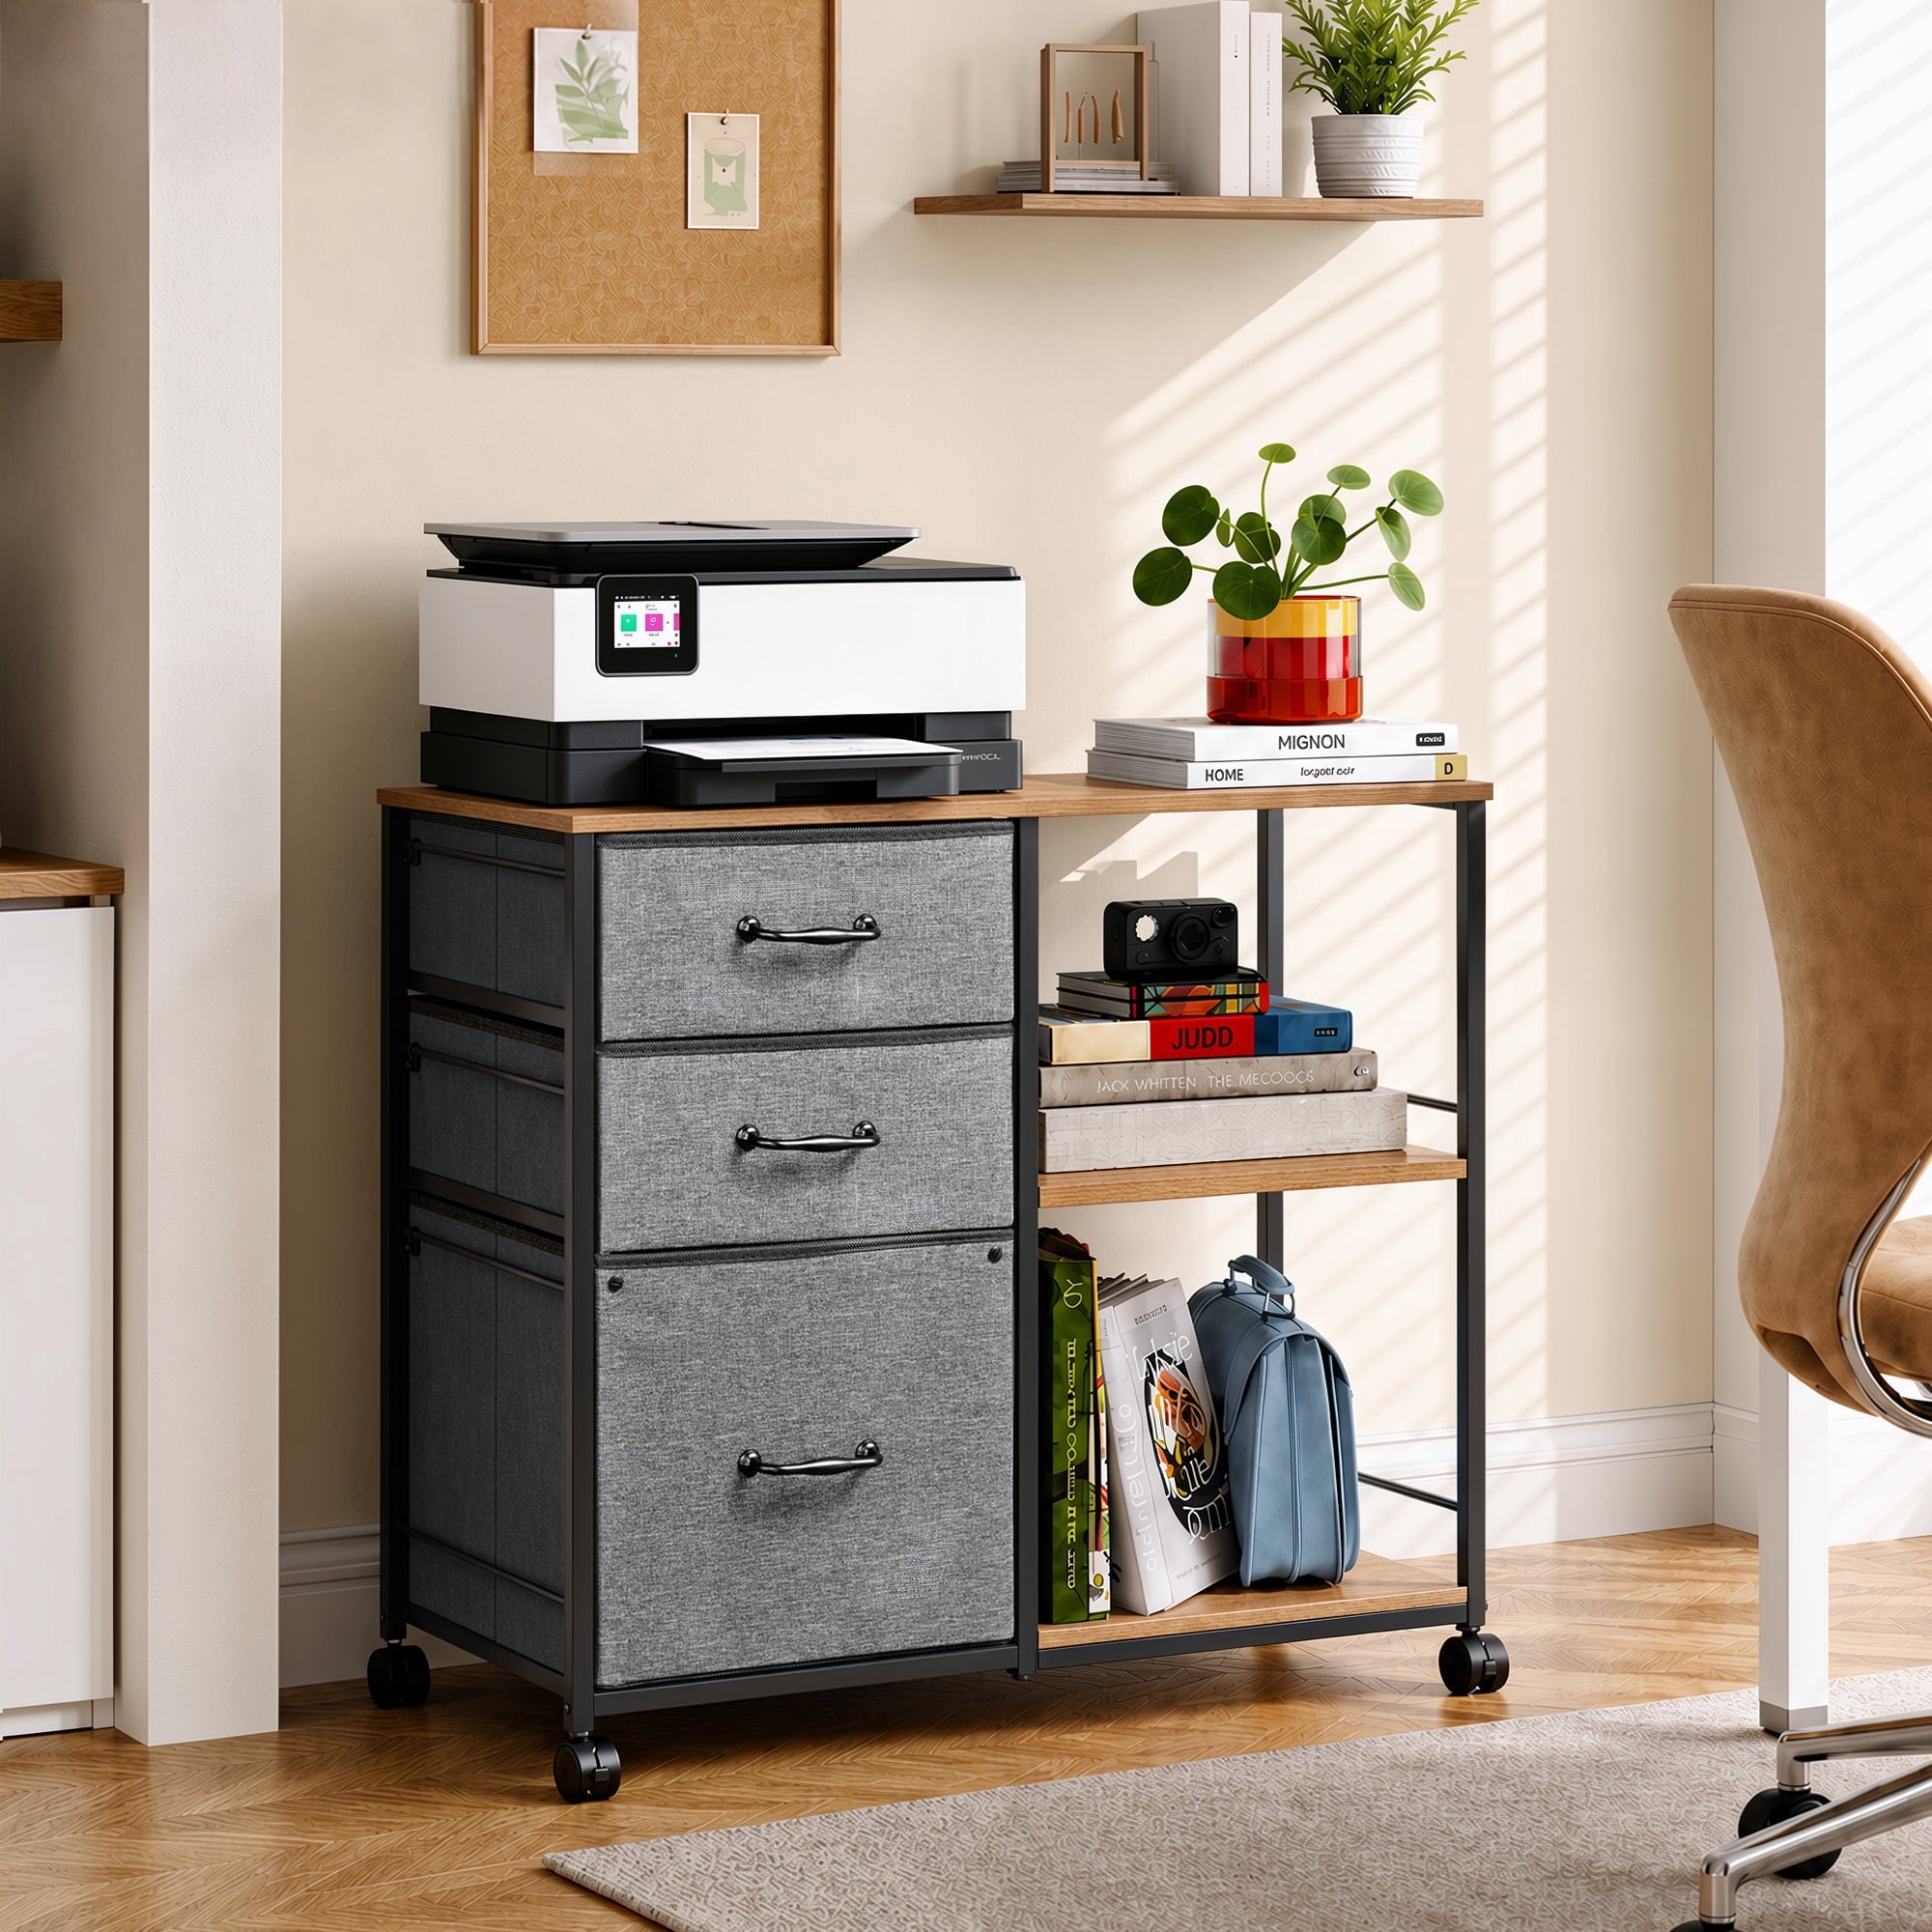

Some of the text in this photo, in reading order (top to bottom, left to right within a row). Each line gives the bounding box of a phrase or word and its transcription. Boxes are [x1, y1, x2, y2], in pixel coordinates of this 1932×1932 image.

[1278, 734, 1345, 751] MIGNON
[1205, 768, 1244, 781] HOME
[1444, 762, 1454, 775] D
[1172, 1026, 1234, 1050] JUDD
[1134, 1077, 1197, 1091] WHITTEN
[1208, 1073, 1233, 1089] THE
